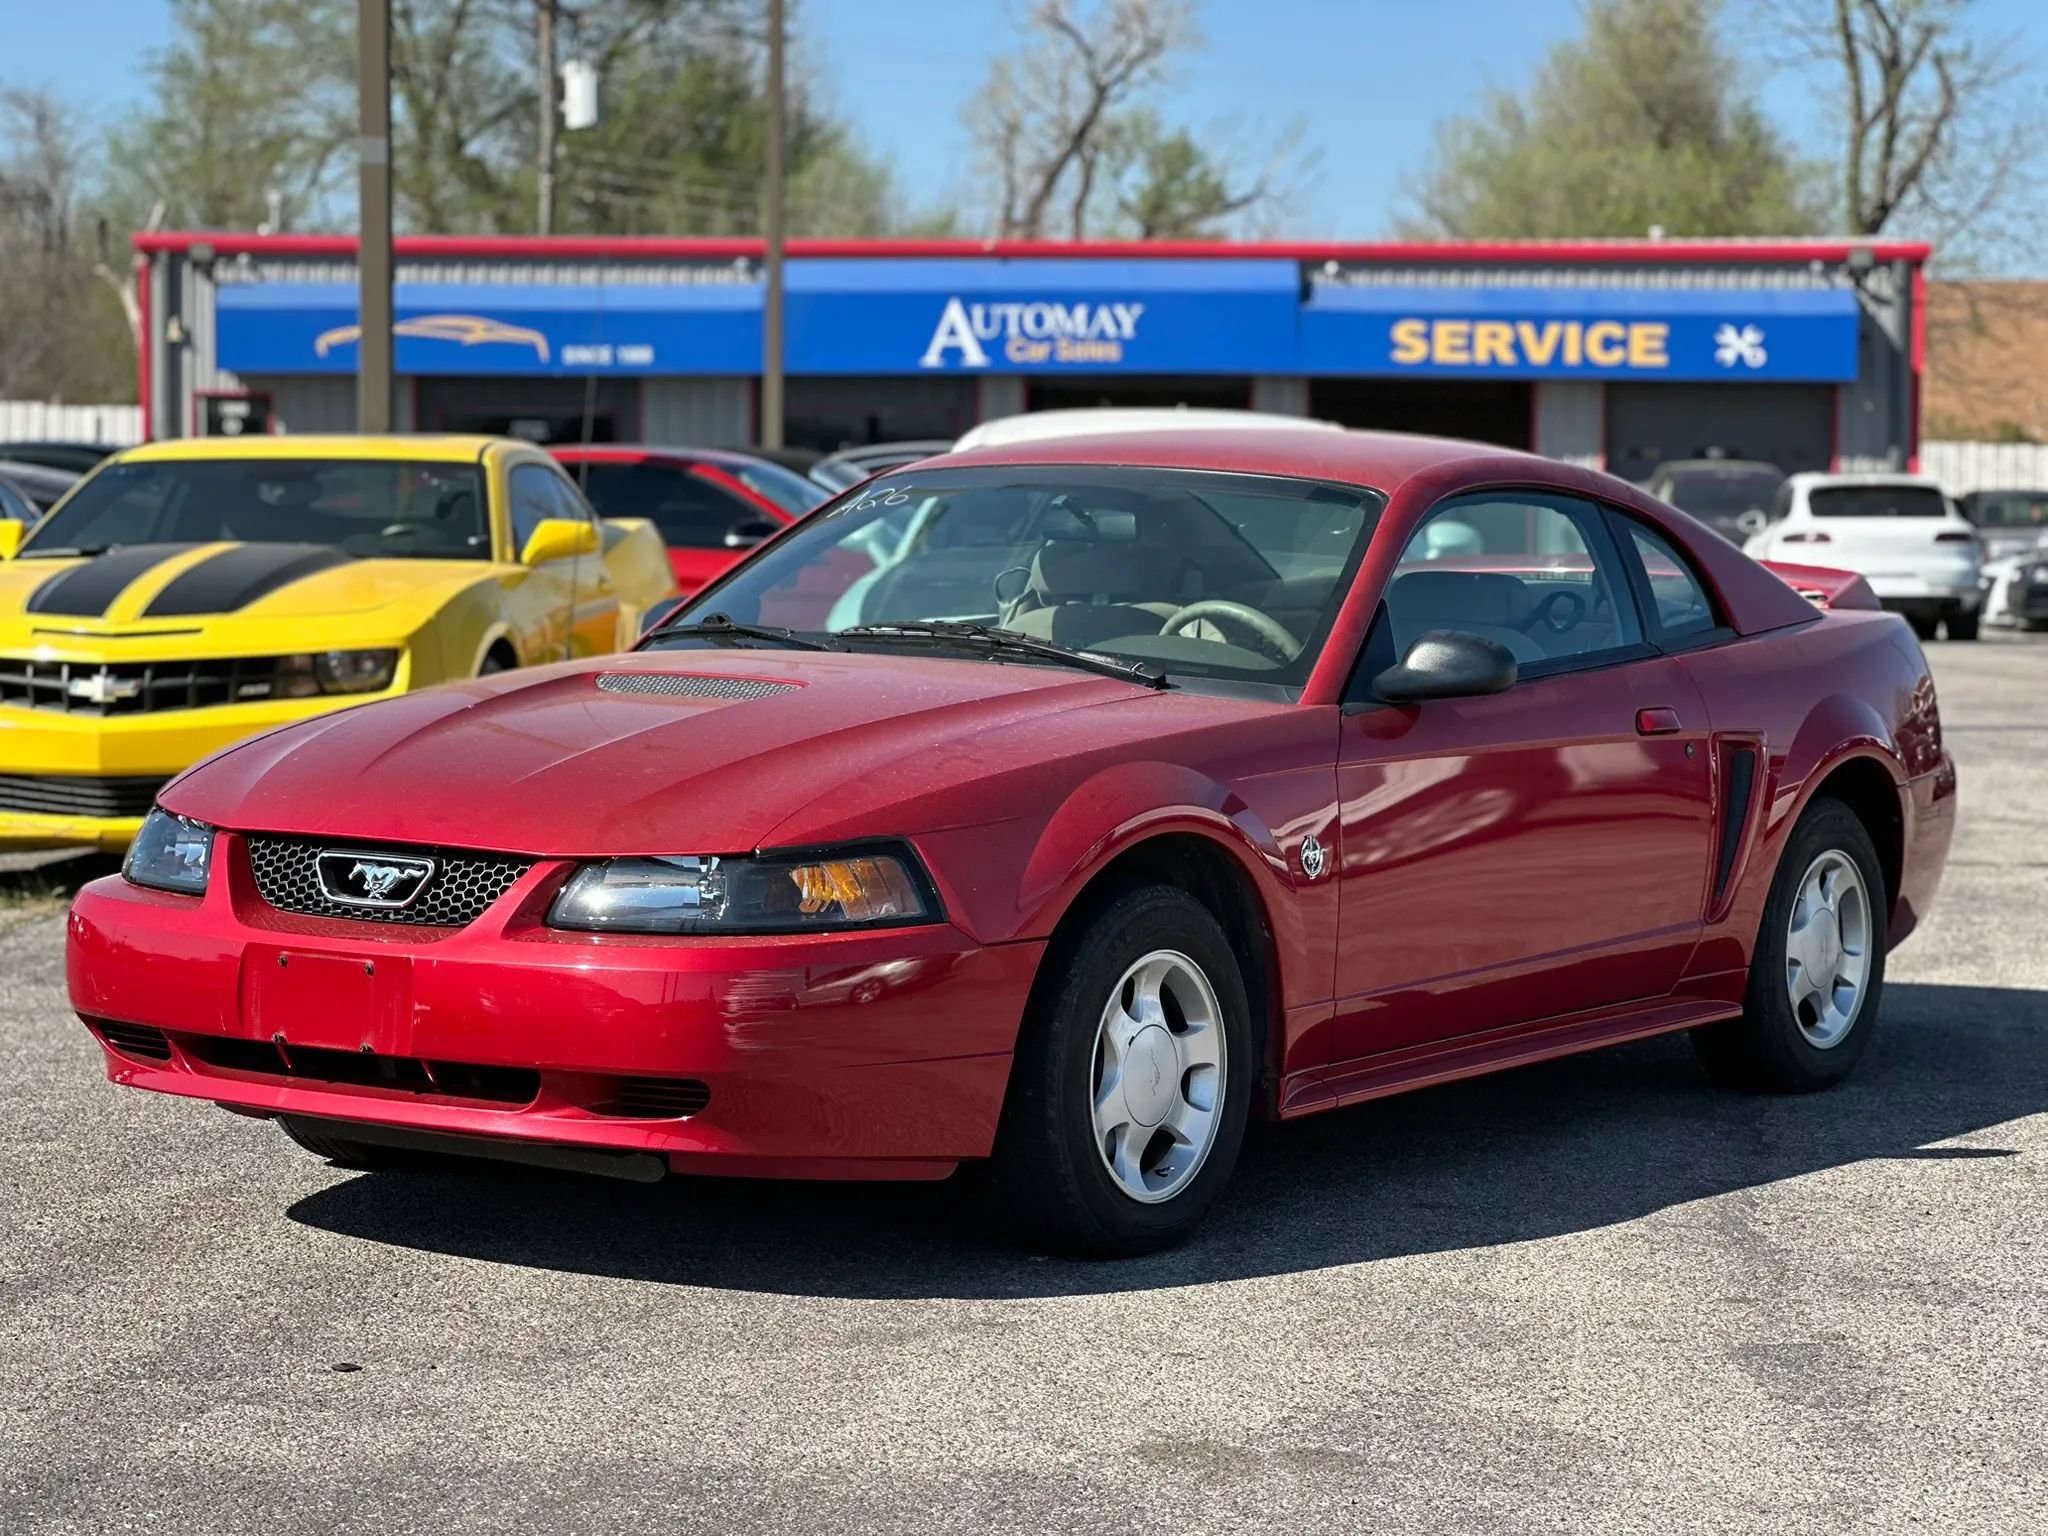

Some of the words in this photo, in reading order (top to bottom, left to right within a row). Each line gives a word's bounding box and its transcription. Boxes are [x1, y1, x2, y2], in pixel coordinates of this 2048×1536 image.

[919, 297, 1144, 367] AUTOMAY
[1005, 337, 1050, 363] Car
[1055, 338, 1122, 363] Sales
[1390, 318, 1669, 367] SERVICE
[561, 344, 613, 366] SINCE
